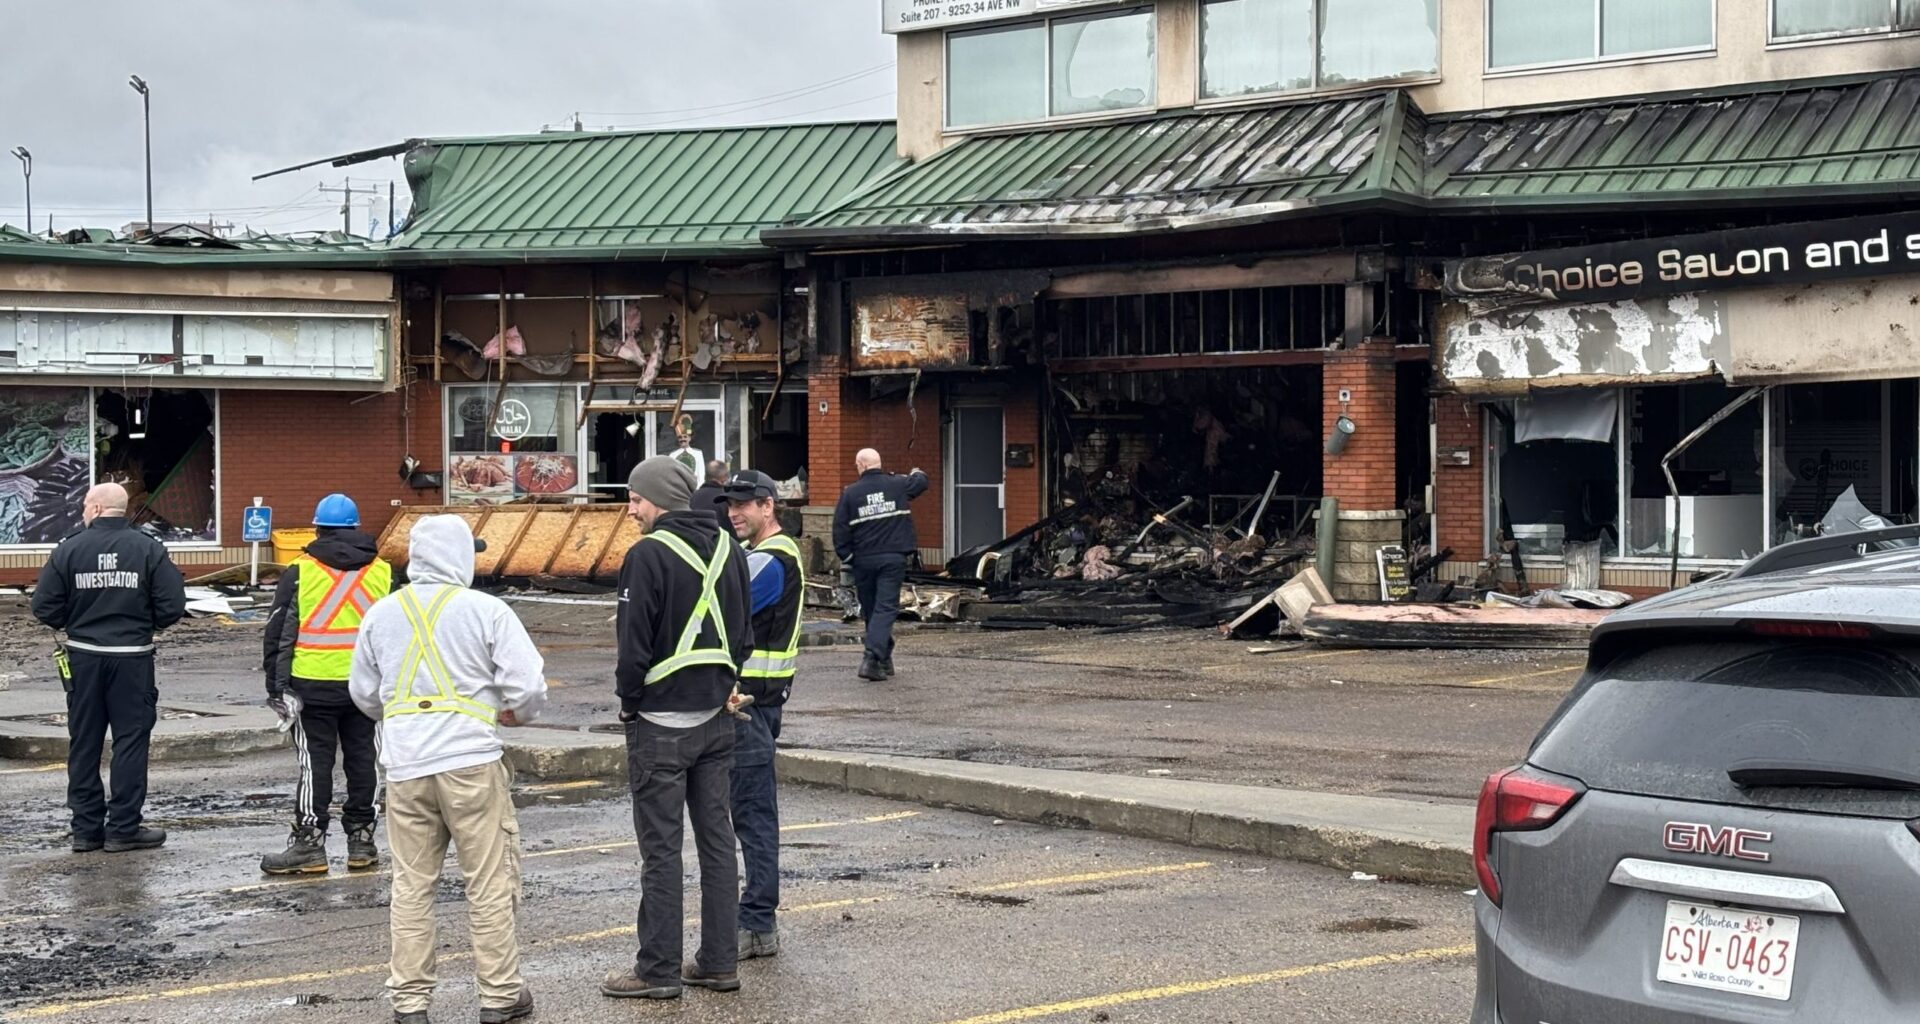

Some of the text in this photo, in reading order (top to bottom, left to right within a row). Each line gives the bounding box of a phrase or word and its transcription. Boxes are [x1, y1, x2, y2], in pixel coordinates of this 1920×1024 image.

[900, 12, 921, 23] Suite
[923, 8, 940, 20] 207
[948, 2, 985, 17] 9252-34
[987, 0, 1003, 11] AVE
[1006, 0, 1020, 8] NW
[1513, 258, 1644, 292] Choice
[1657, 246, 1790, 281] Salon
[1805, 229, 1890, 268] and
[500, 425, 522, 434] HALAL
[1823, 459, 1869, 472] HOICE
[866, 491, 885, 505] FIRE
[858, 500, 896, 517] INVESTIGATOR
[98, 552, 118, 570] FIRE
[75, 571, 138, 589] INVESTIGATOR
[1663, 821, 1772, 862] GMC
[1690, 908, 1733, 928] Alberta
[1665, 926, 1790, 977] CSV-0463
[1692, 969, 1755, 988] Wild Rose Country
